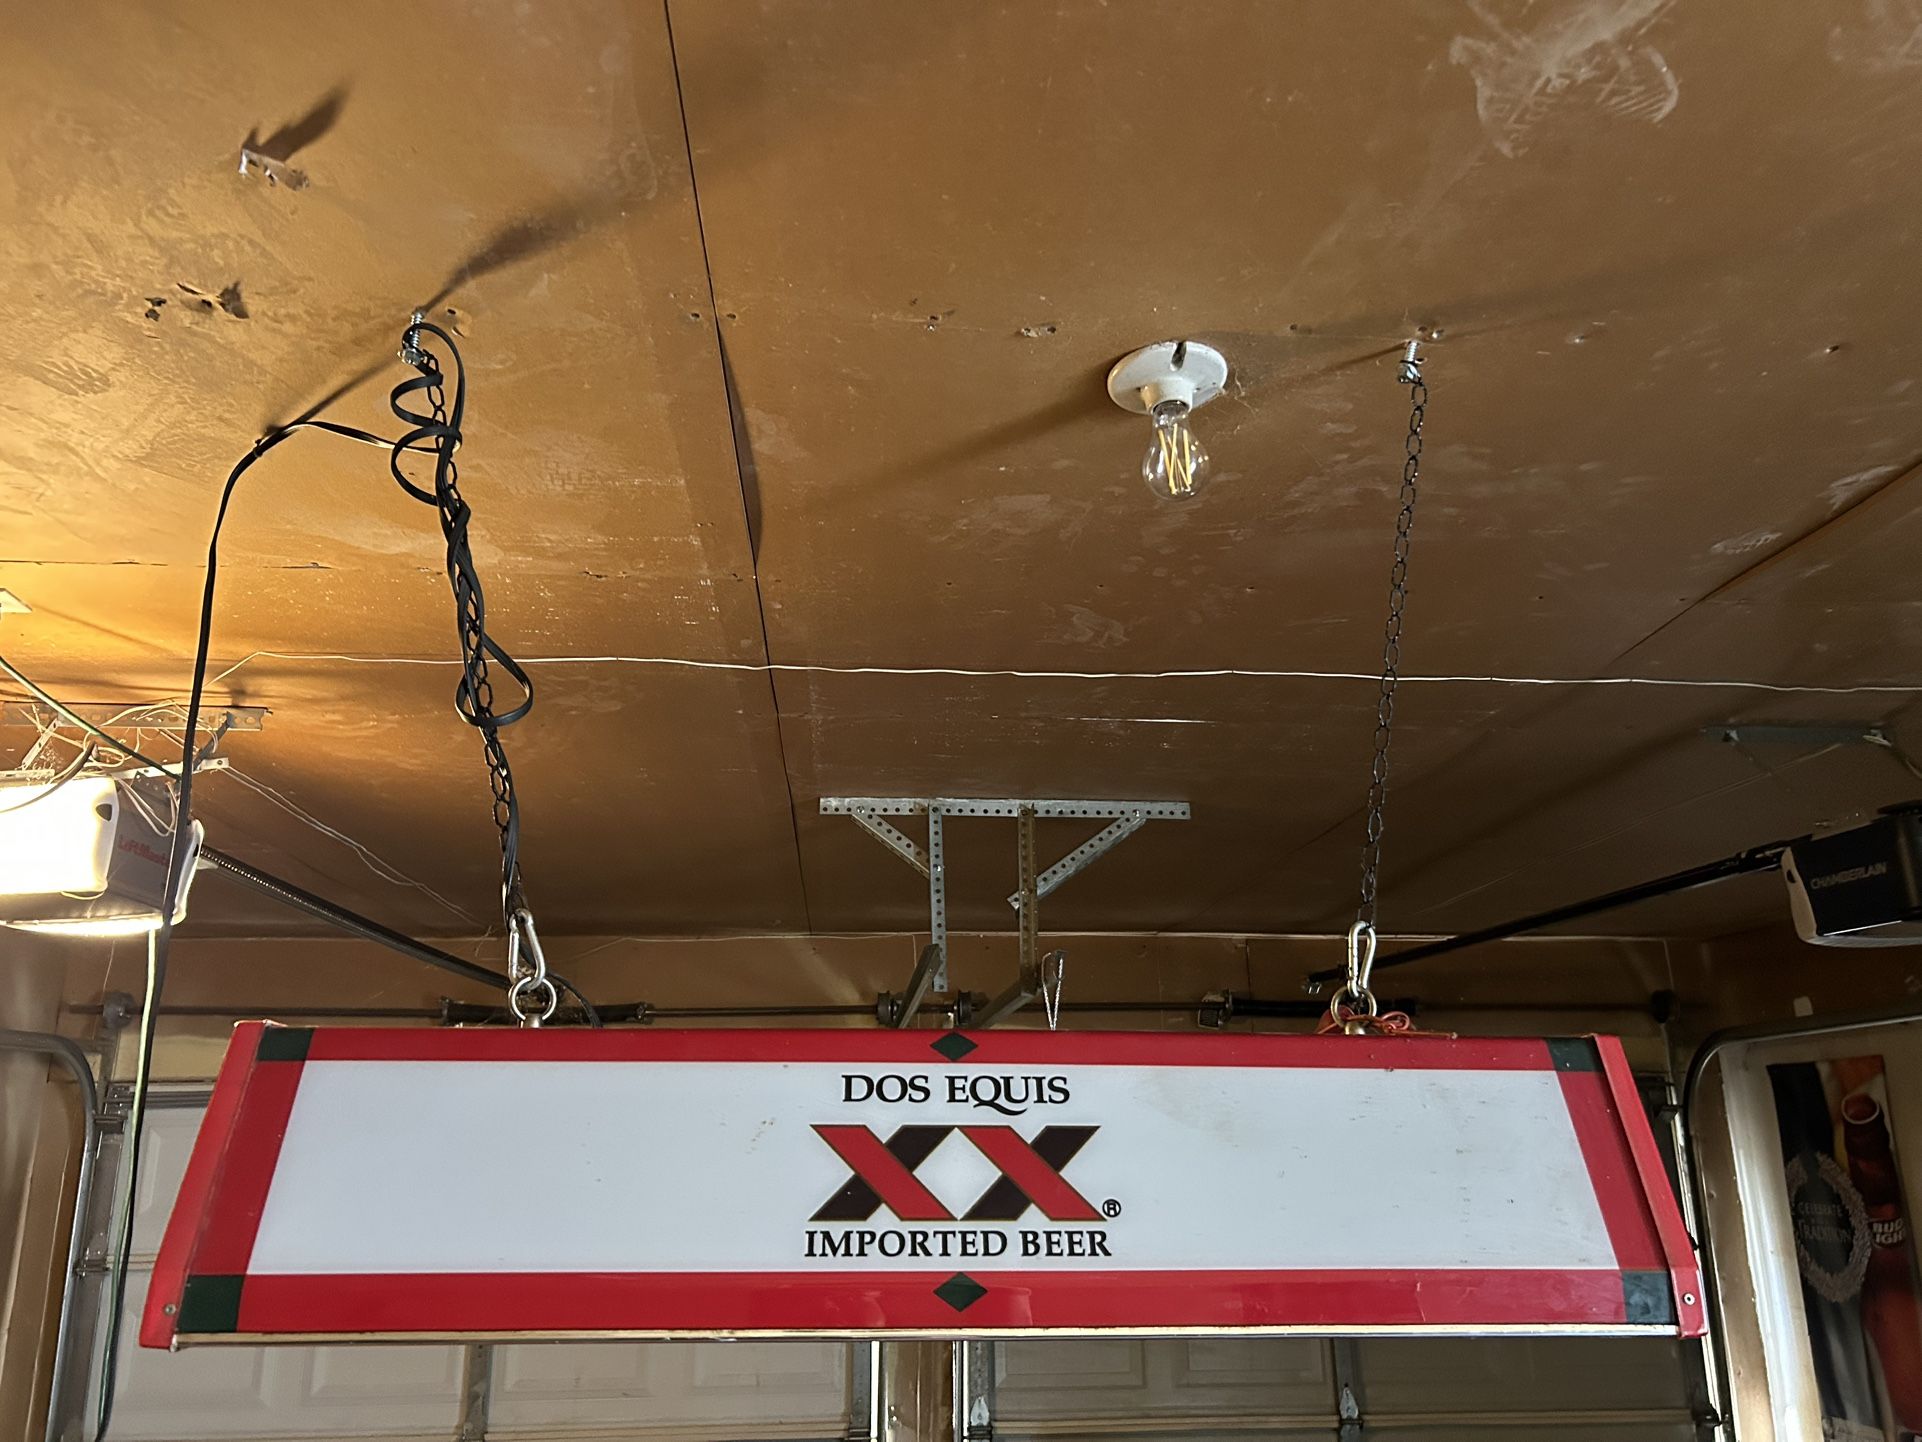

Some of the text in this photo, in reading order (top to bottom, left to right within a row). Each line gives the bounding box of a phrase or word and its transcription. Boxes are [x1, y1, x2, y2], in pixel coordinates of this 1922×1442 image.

[118, 837, 169, 867] LiftMast
[1810, 862, 1886, 889] CHAMBERLAIN
[841, 1074, 1071, 1117] DOS EQUIS
[808, 1123, 1108, 1222] XX
[1872, 1218, 1904, 1233] BUD
[1875, 1231, 1904, 1244] IGH
[804, 1230, 1113, 1257] IMPORTED BEER
